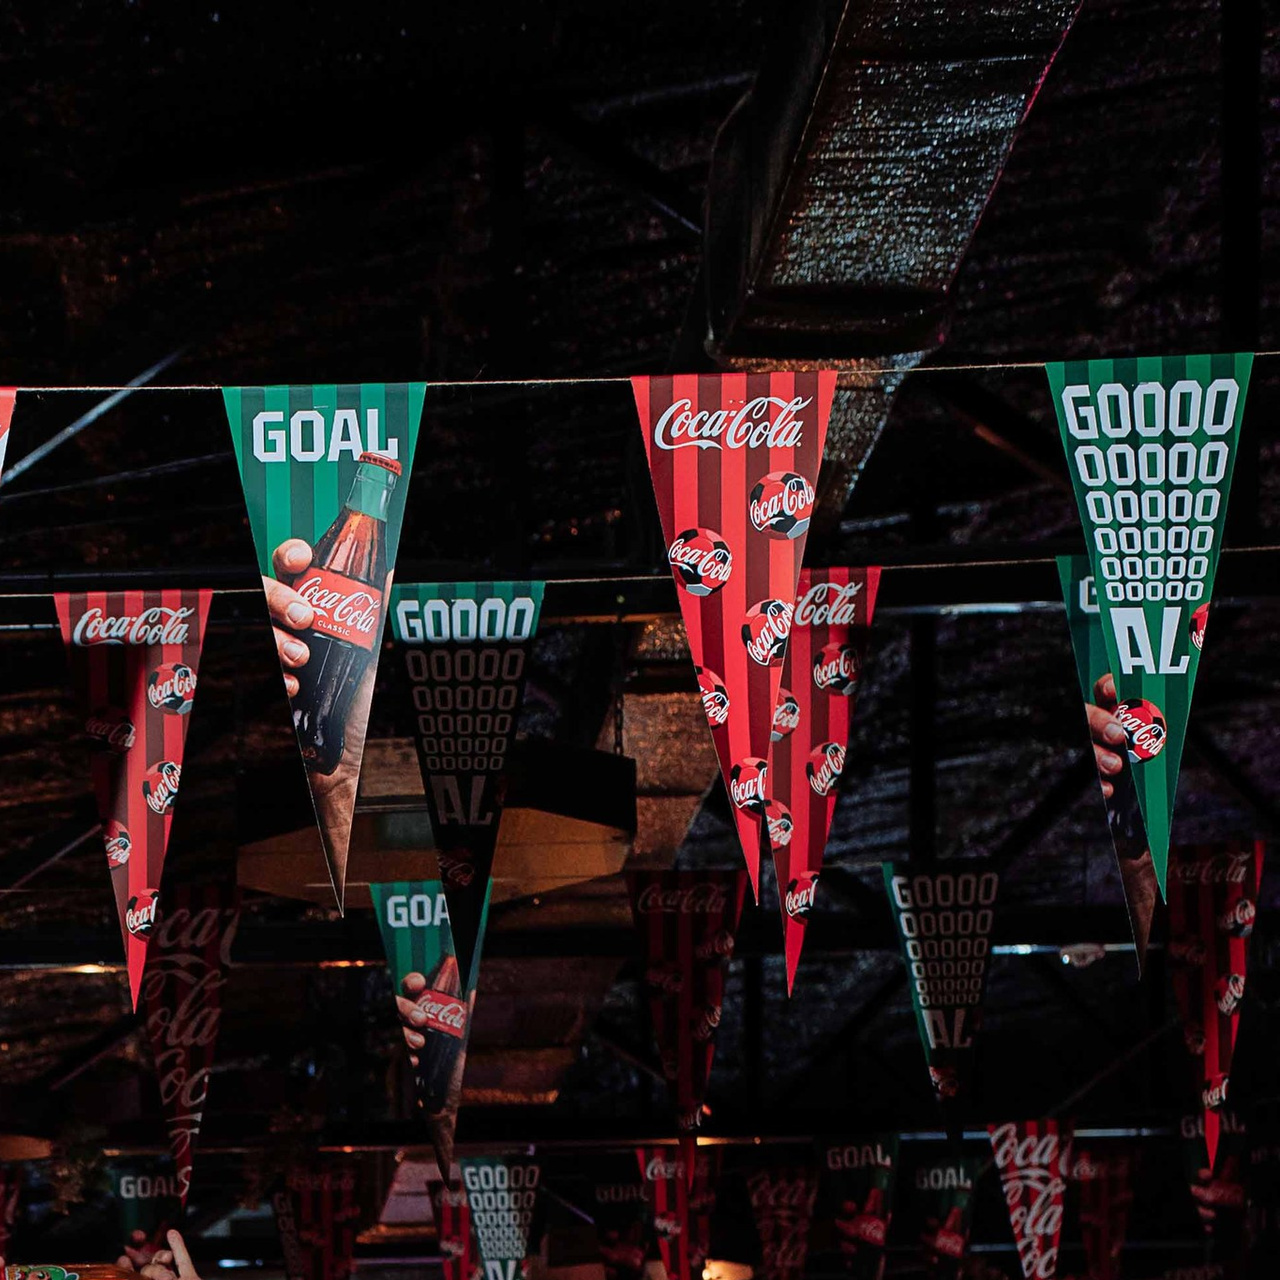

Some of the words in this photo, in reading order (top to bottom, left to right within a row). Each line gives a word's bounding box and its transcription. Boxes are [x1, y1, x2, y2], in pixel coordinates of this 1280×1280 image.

[253, 409, 399, 463] GOAL
[654, 397, 814, 450] Coca-Cola
[795, 582, 863, 627] -Cola
[73, 606, 194, 646] Coca-Cola
[317, 619, 351, 637] CLASSIC
[1109, 606, 1190, 675] AL
[431, 775, 494, 825] AL
[386, 893, 451, 929] GOA
[923, 1008, 973, 1048] AL
[1181, 1111, 1247, 1138] GAL
[827, 1142, 892, 1171] GOAL
[917, 1163, 973, 1190] GOAL
